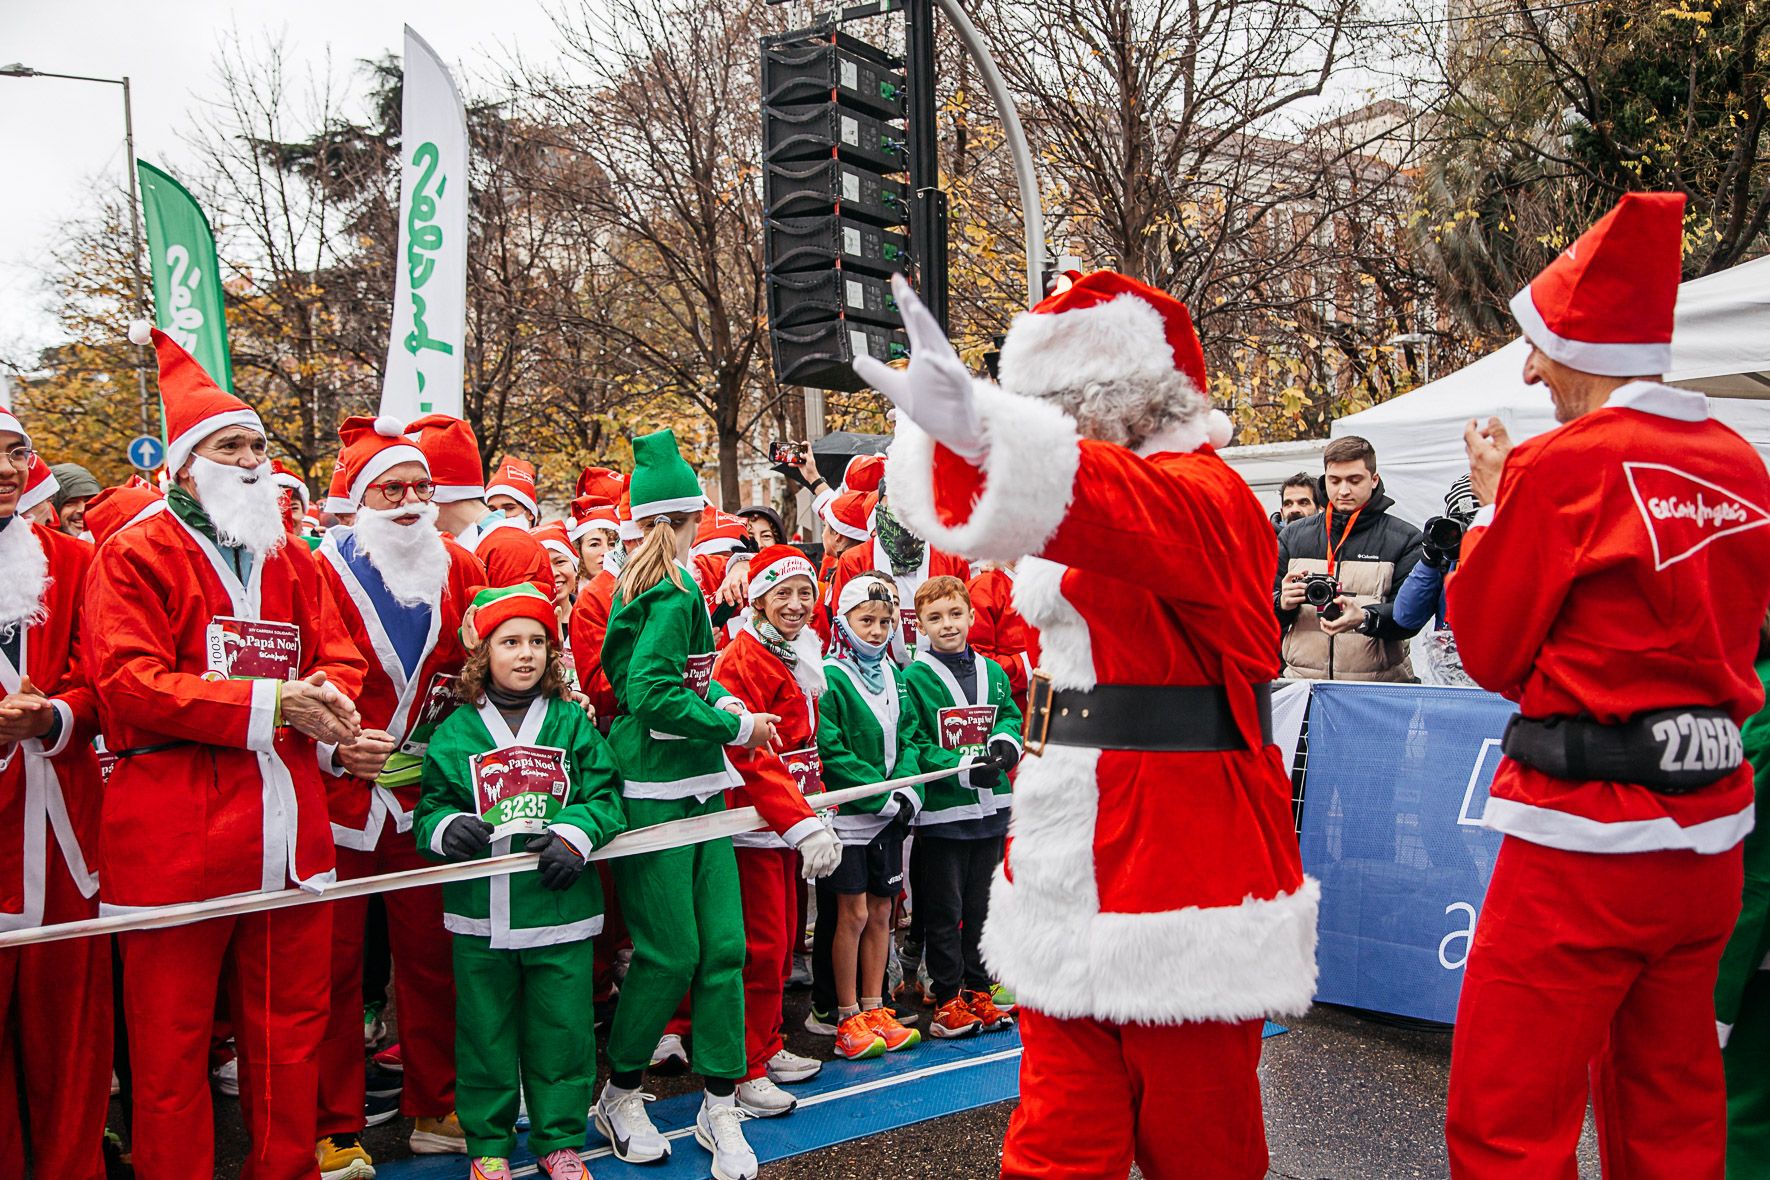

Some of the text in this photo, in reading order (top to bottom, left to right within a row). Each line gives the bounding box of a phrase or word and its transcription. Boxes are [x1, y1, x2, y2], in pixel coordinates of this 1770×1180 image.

[210, 635, 223, 666] 1003
[246, 635, 297, 651] Papá Noel
[508, 757, 557, 771] Papá Noel
[500, 793, 548, 823] 3235
